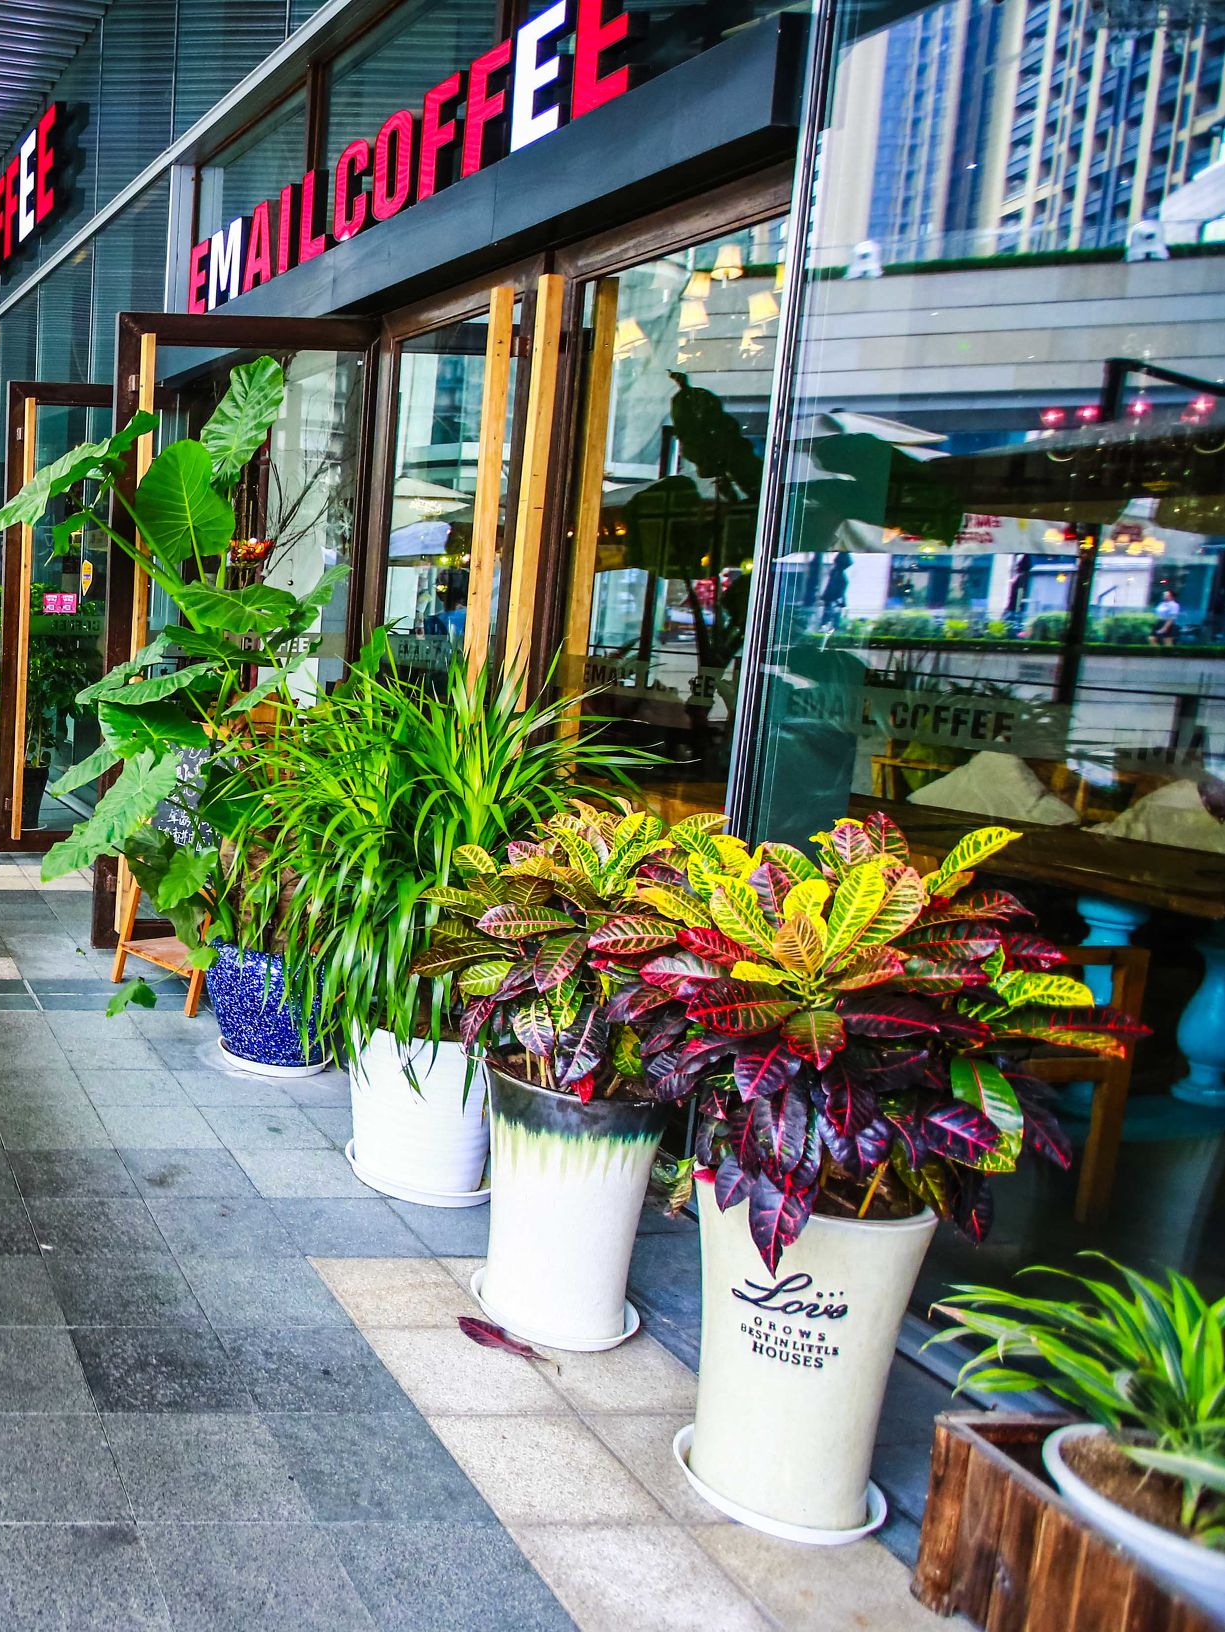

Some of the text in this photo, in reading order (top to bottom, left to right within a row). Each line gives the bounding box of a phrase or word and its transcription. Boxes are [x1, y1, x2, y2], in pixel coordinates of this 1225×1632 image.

[188, 0, 632, 315] EMAIL COFFEE
[889, 701, 1015, 743] COFFEE
[731, 1272, 848, 1319] Love
[740, 1322, 840, 1357] BEST IN LITTLE
[753, 1315, 826, 1342] GROWS
[752, 1339, 825, 1370] HOUSES
